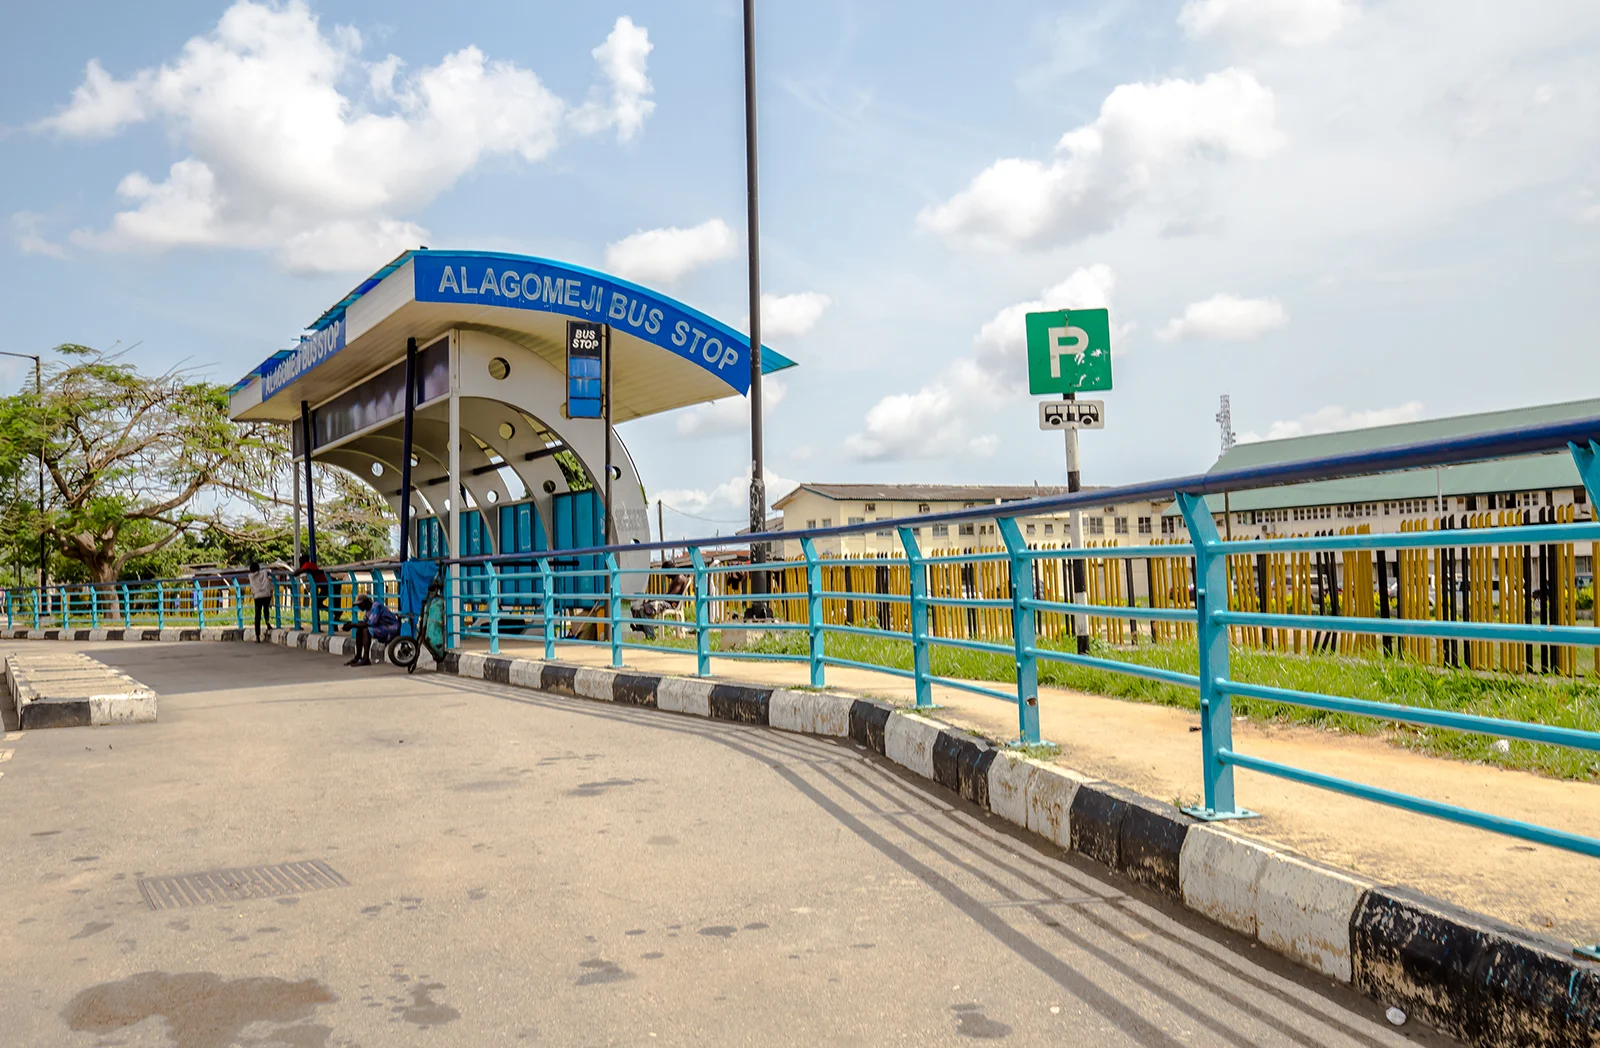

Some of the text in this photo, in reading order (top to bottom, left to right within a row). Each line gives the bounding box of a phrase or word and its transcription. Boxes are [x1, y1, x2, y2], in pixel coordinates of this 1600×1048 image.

[438, 265, 739, 370] ALAGOMEJI BUS STOP
[575, 328, 596, 340] BUS
[302, 336, 317, 371] BUS
[317, 319, 340, 359] STOP
[572, 339, 599, 350] STOP
[1048, 326, 1089, 378] P
